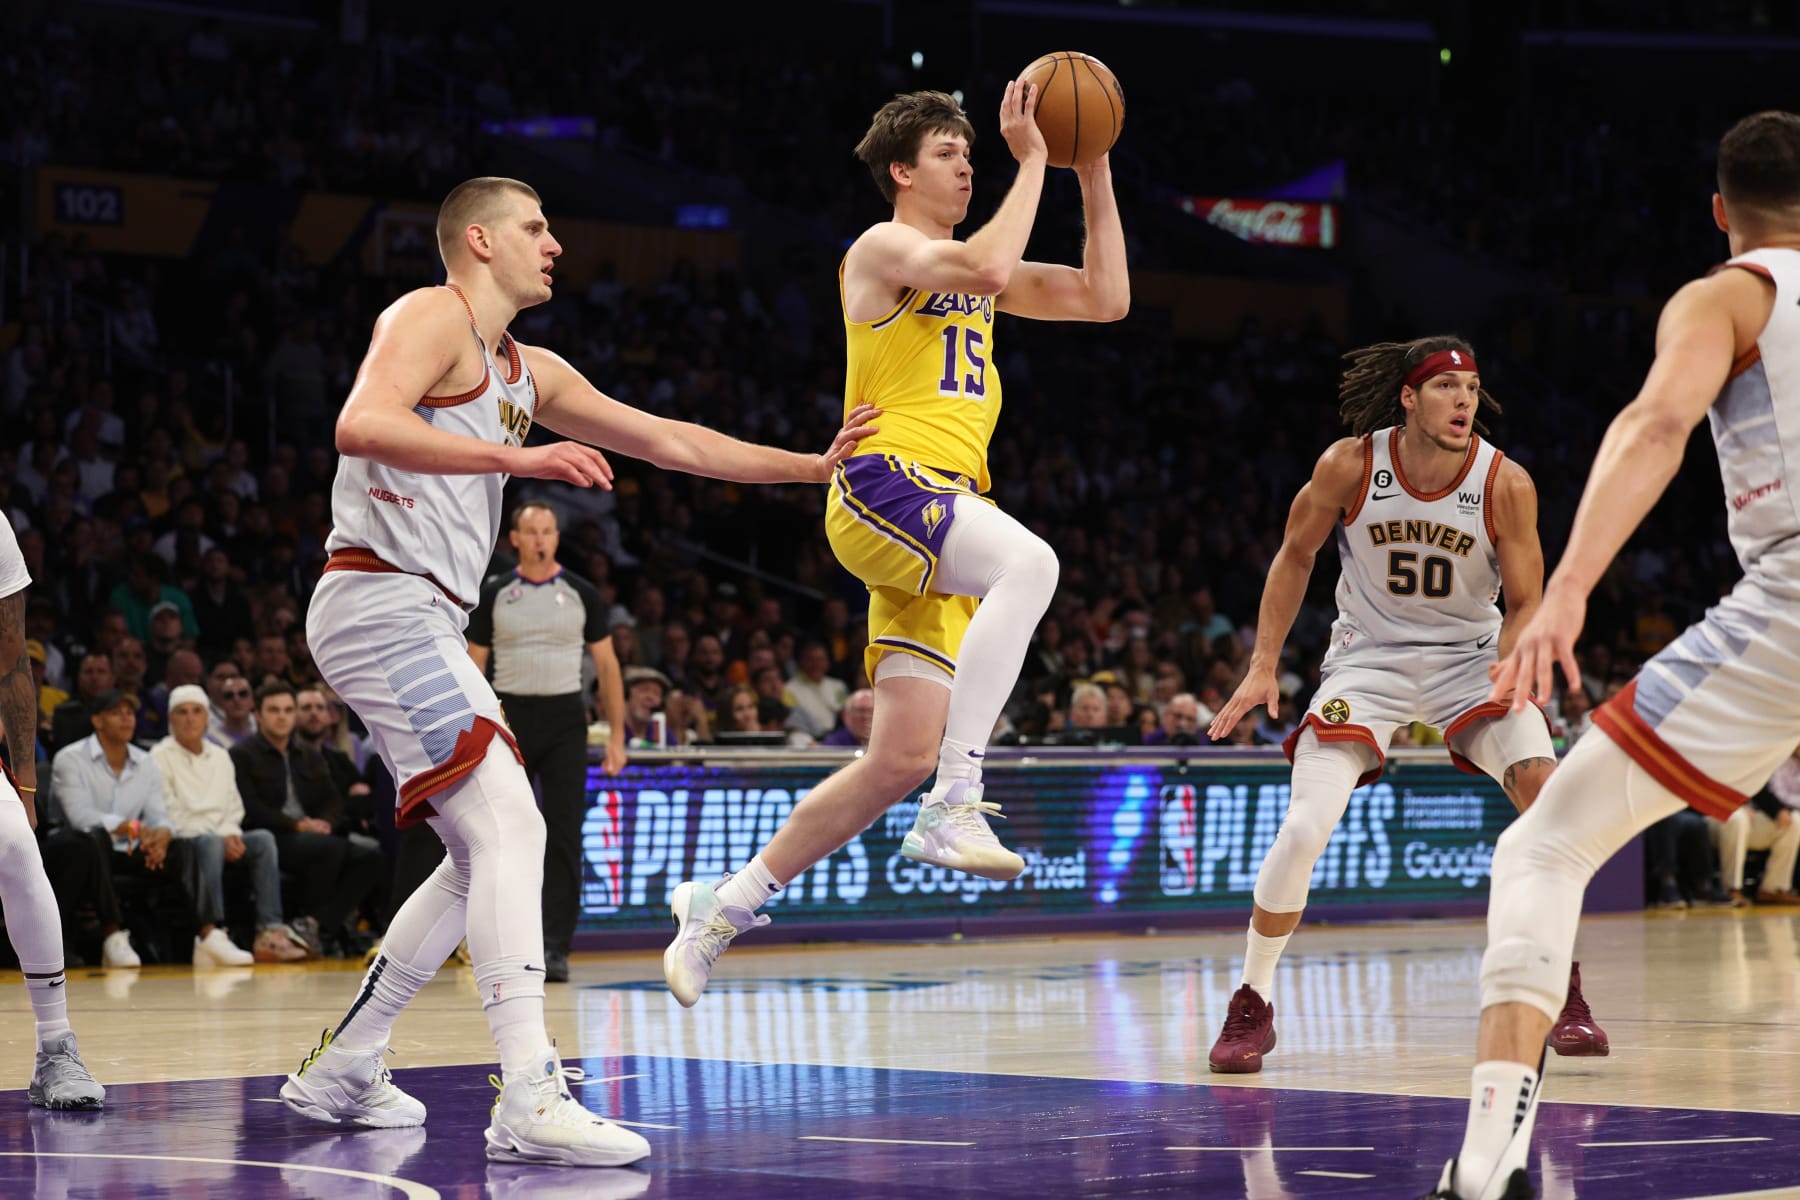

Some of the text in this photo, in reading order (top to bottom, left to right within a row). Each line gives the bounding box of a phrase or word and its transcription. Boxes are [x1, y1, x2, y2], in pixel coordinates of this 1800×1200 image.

[61, 188, 118, 220] 102
[939, 325, 987, 401] 15
[367, 487, 415, 509] NUGGETS
[1458, 491, 1481, 505] WU
[1367, 520, 1477, 557] DENVER
[1387, 550, 1454, 599] 50
